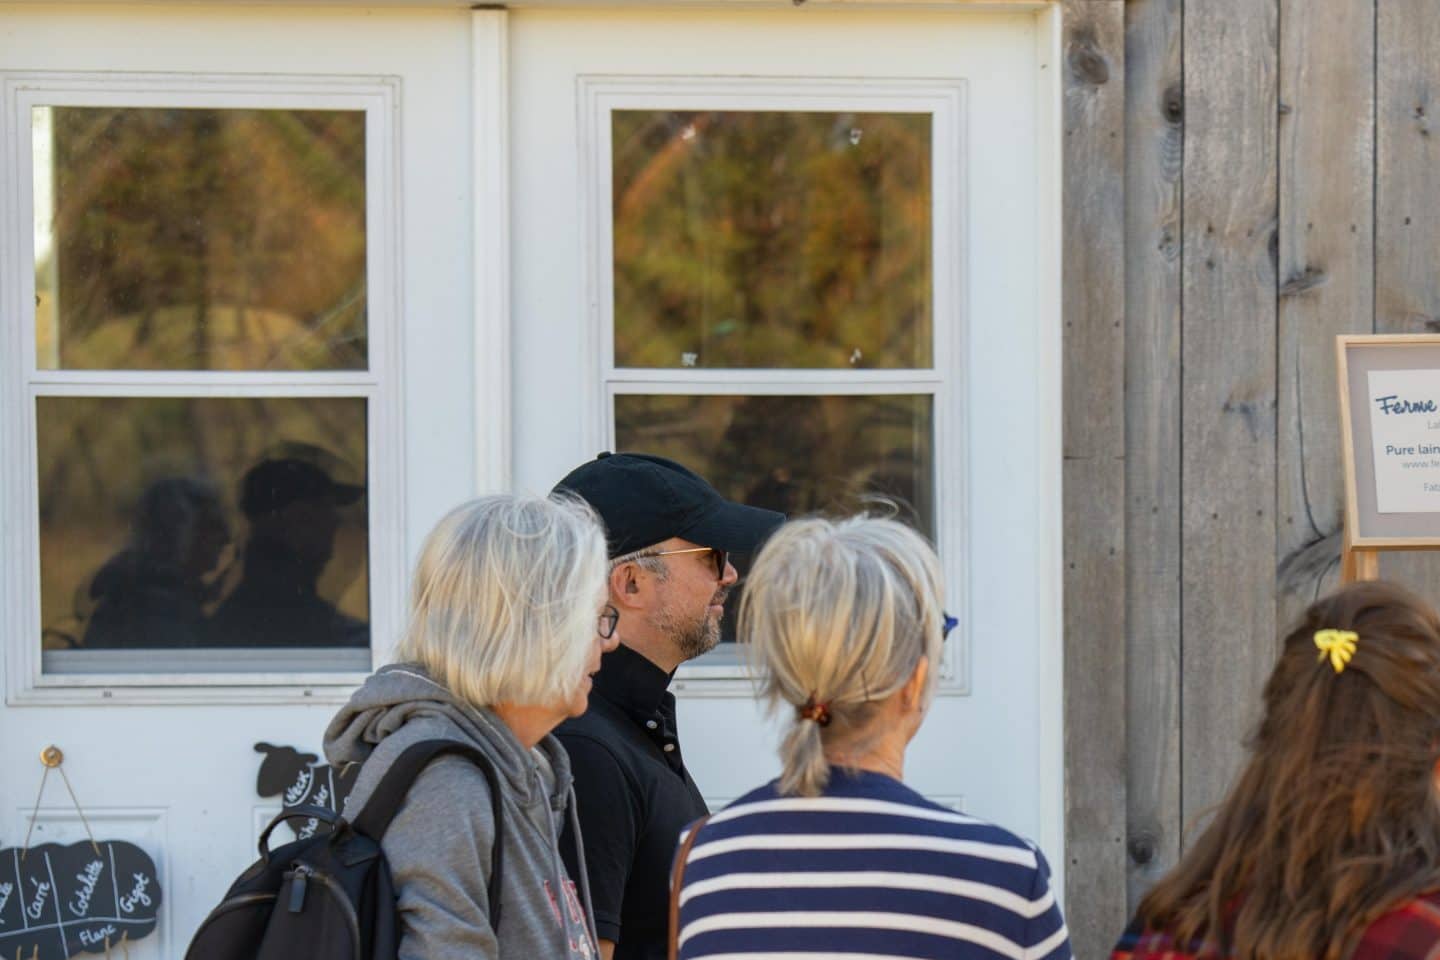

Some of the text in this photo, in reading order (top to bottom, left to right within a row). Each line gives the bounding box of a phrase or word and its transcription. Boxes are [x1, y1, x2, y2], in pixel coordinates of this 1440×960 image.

[1376, 394, 1437, 415] Ferme
[1386, 445, 1415, 456] Pure
[120, 872, 151, 913] Gigot
[79, 924, 117, 946] Flanc
